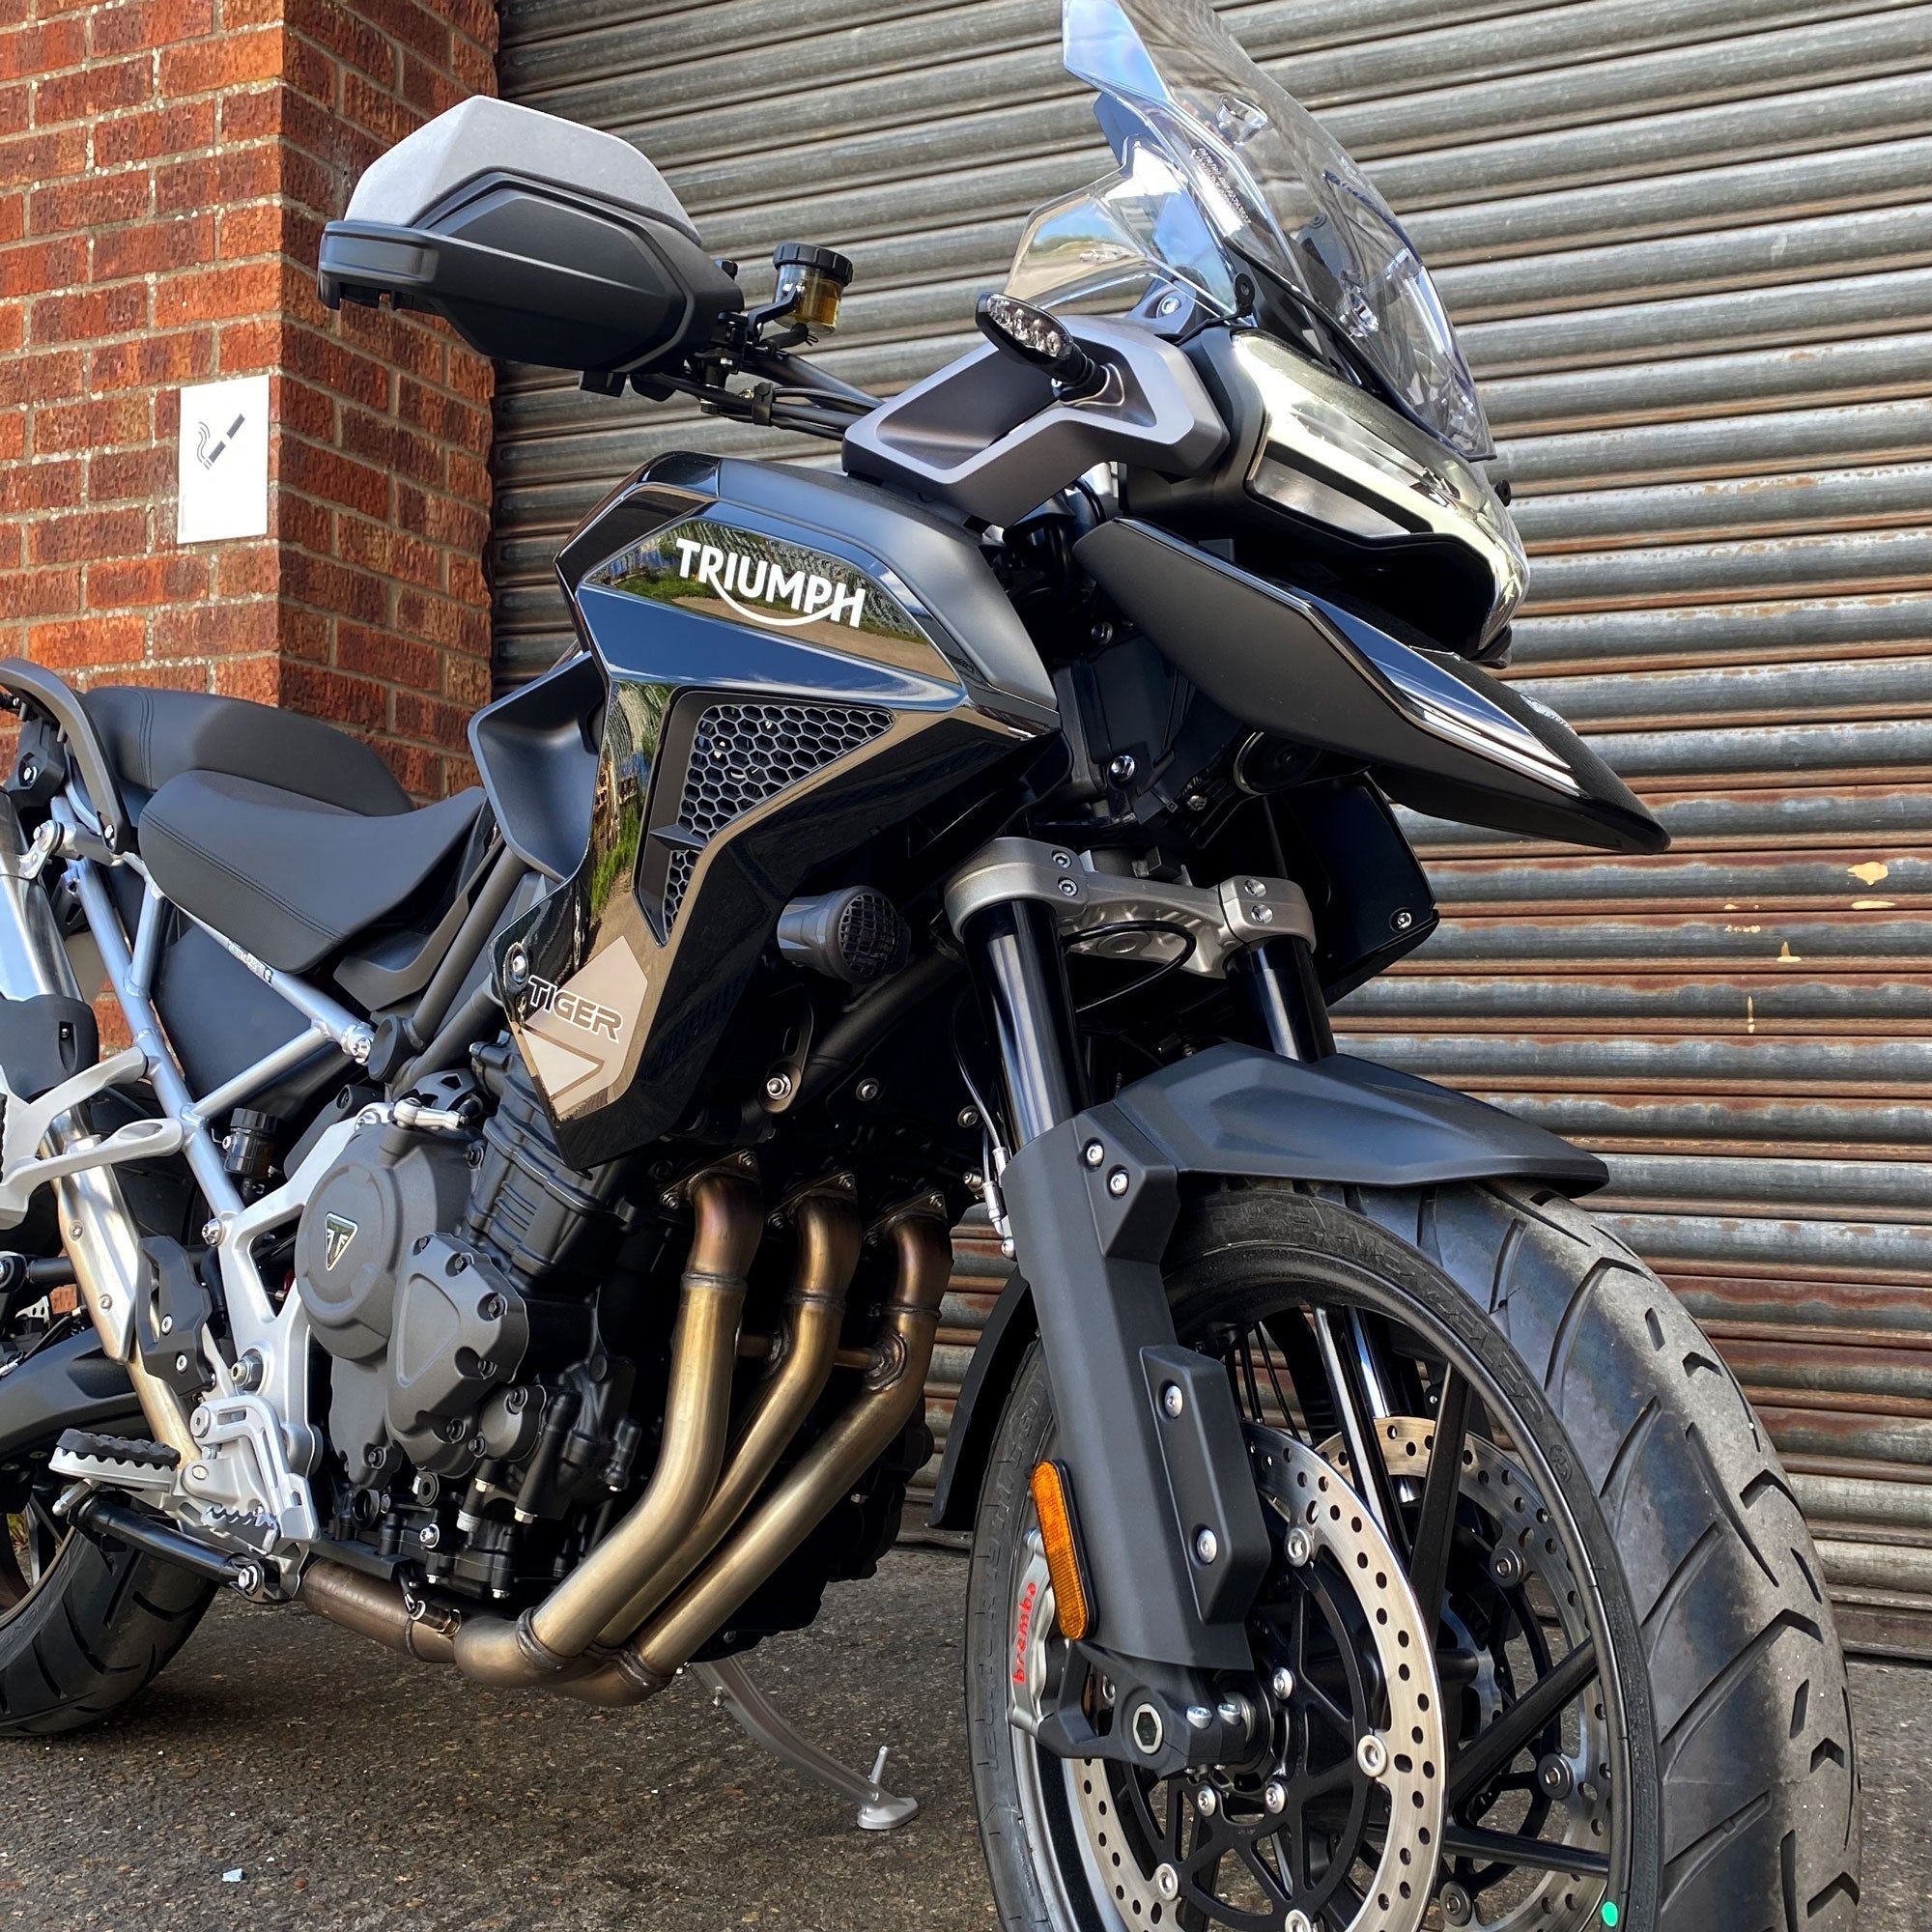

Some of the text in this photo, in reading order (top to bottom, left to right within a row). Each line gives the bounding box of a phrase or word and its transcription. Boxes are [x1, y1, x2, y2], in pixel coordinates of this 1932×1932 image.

[676, 537, 866, 628] TRIUMPH
[527, 974, 624, 1044] TIGER
[1012, 1581, 1037, 1685] brembo
